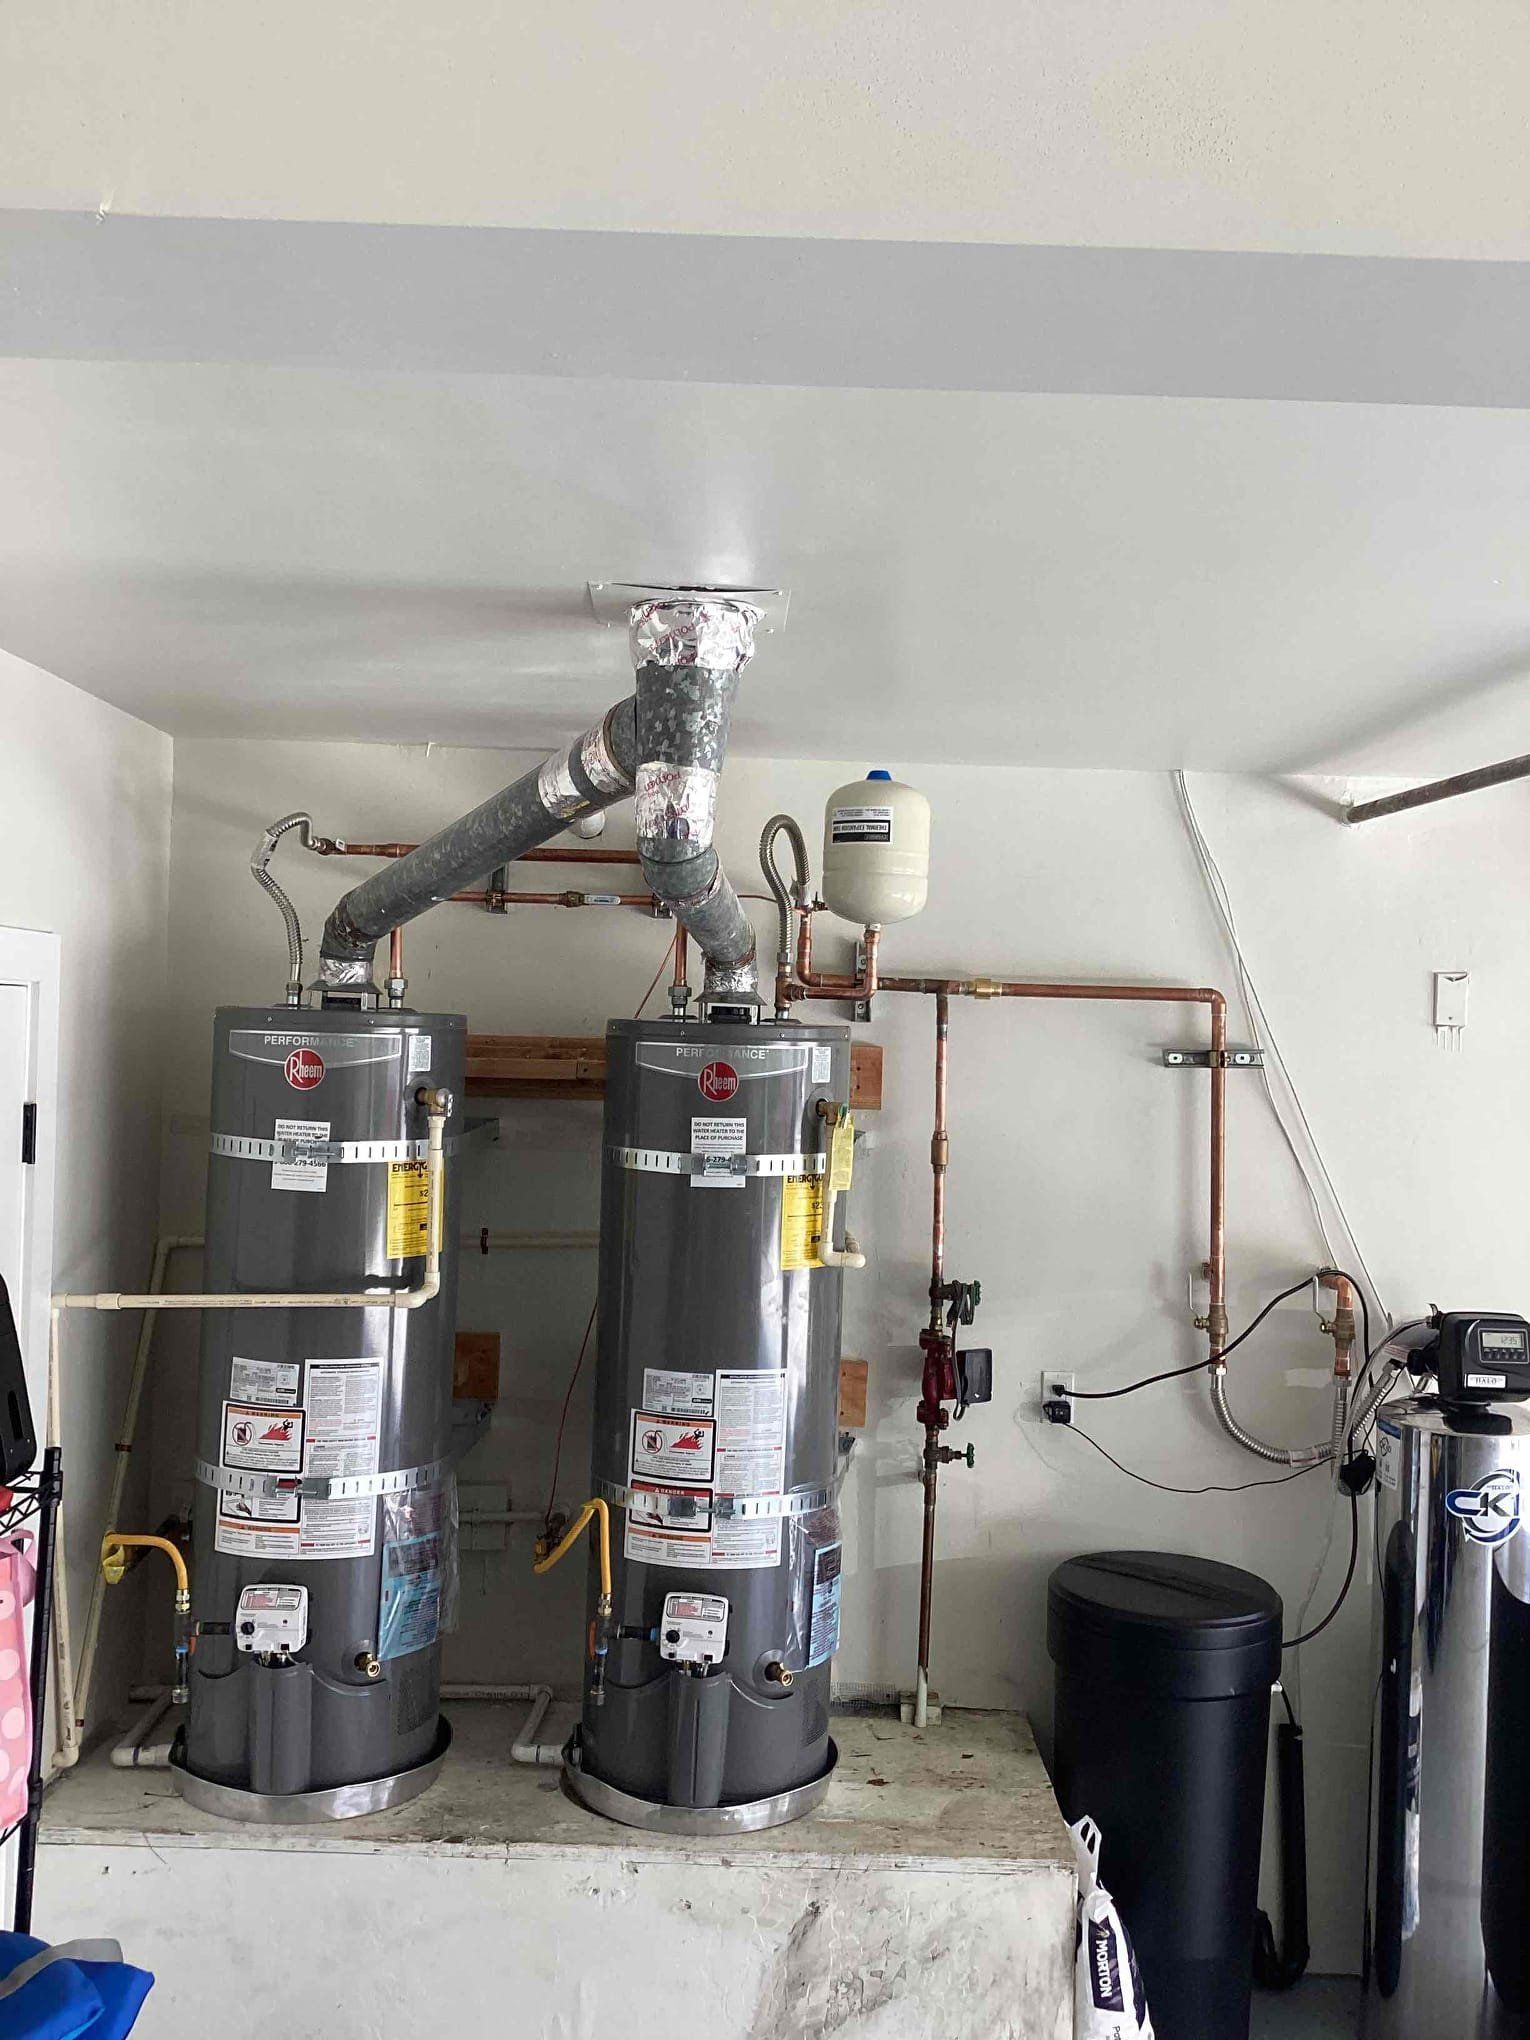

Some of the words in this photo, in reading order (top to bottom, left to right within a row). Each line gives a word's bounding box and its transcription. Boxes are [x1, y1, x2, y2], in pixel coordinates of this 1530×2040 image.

[289, 1051, 322, 1083] Rheem
[676, 1047, 766, 1060] PERFOANCE
[704, 1063, 736, 1095] Rheem
[1096, 1939, 1113, 1998] MORTON
